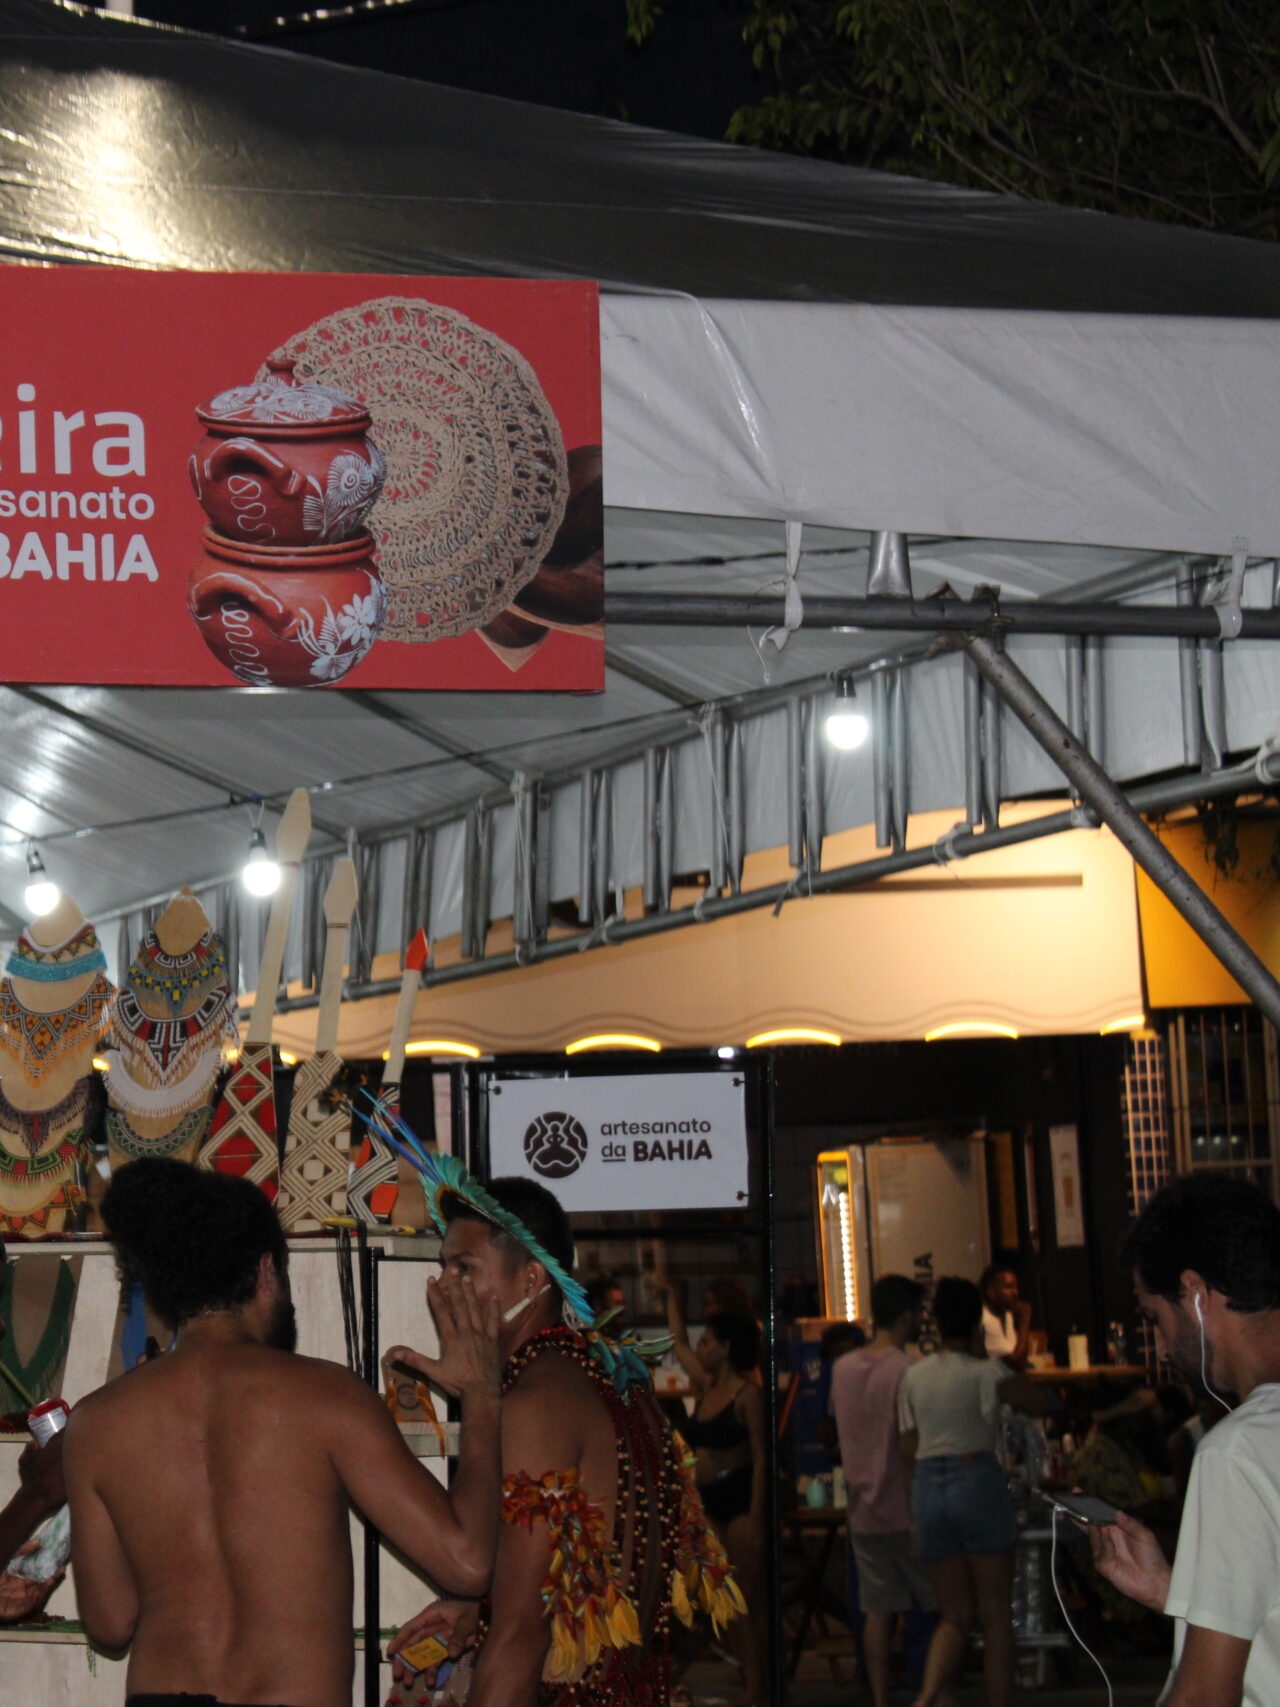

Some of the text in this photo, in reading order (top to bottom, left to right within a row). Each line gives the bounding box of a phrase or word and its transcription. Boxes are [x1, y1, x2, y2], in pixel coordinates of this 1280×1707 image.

[600, 1118, 711, 1136] artesanato
[601, 1139, 712, 1162] da BAHIA
